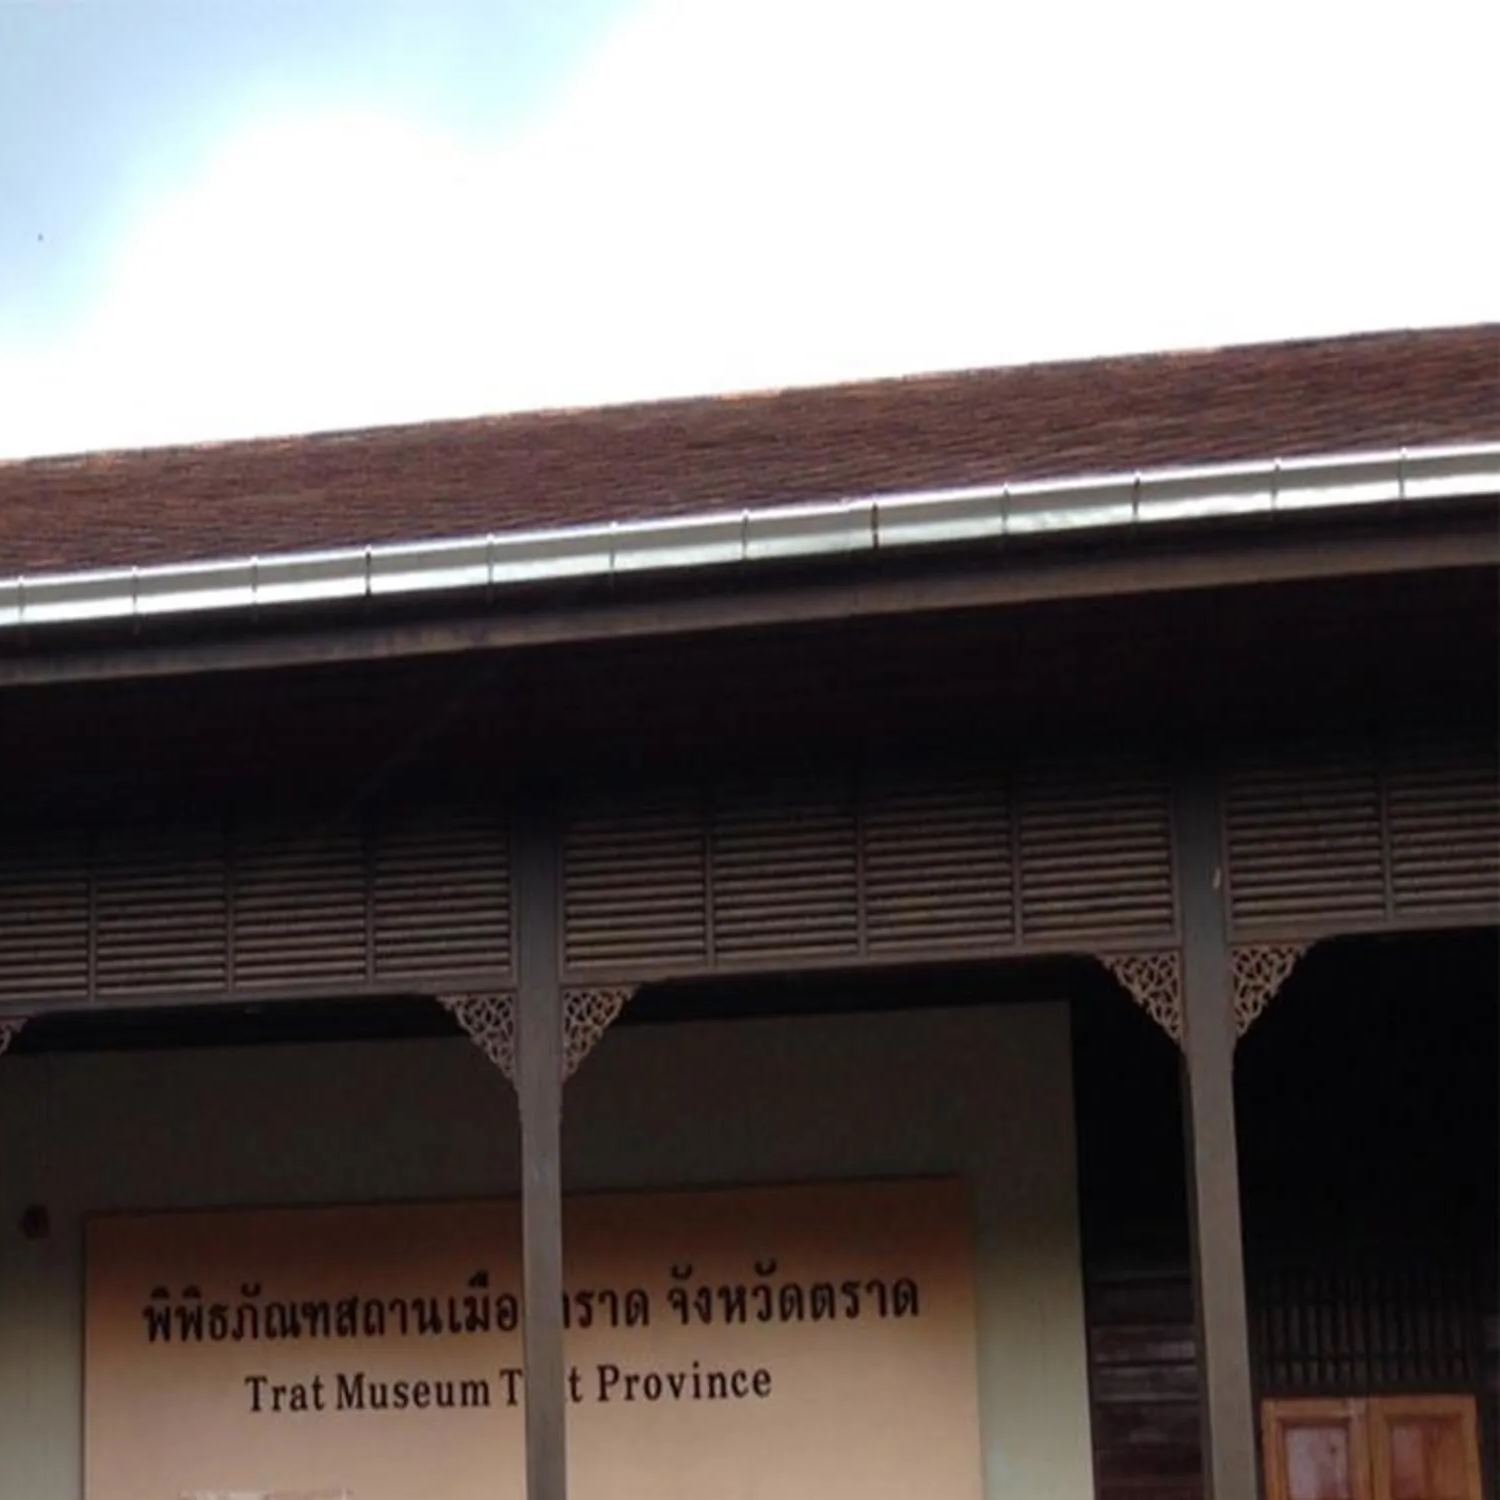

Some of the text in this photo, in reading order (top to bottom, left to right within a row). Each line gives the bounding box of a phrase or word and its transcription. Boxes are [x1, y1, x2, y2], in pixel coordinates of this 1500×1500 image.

[666, 1258, 922, 1325] จังหวัดตราด
[244, 1360, 773, 1413] Trat Museum Tt Province
